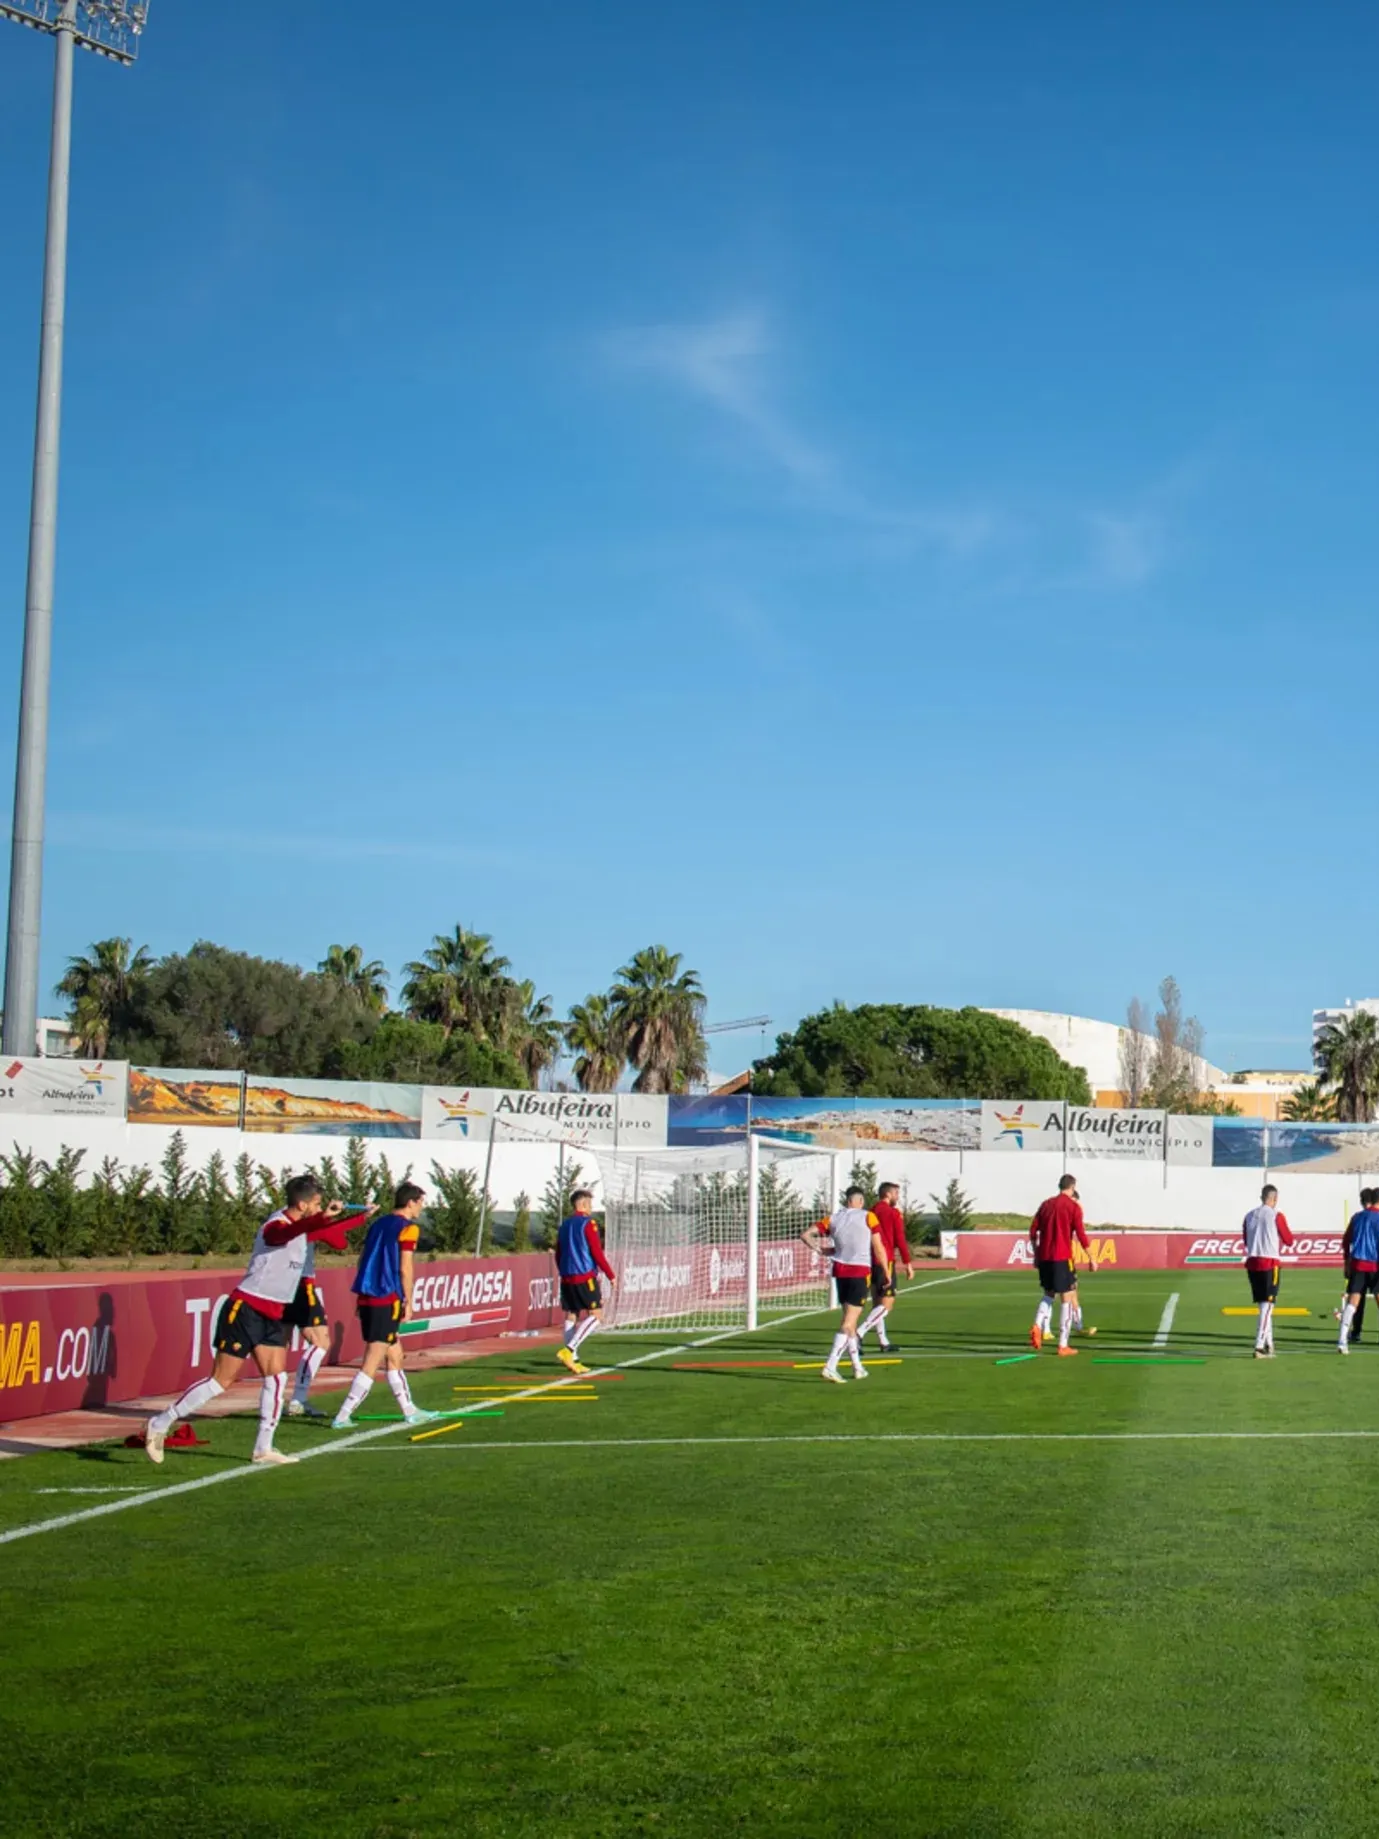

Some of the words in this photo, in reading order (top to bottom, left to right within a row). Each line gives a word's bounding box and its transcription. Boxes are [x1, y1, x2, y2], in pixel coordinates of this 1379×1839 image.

[495, 1094, 612, 1120] Albufeira
[1043, 1111, 1162, 1138] Albufeira
[412, 1269, 513, 1313] ECCIAROSSA
